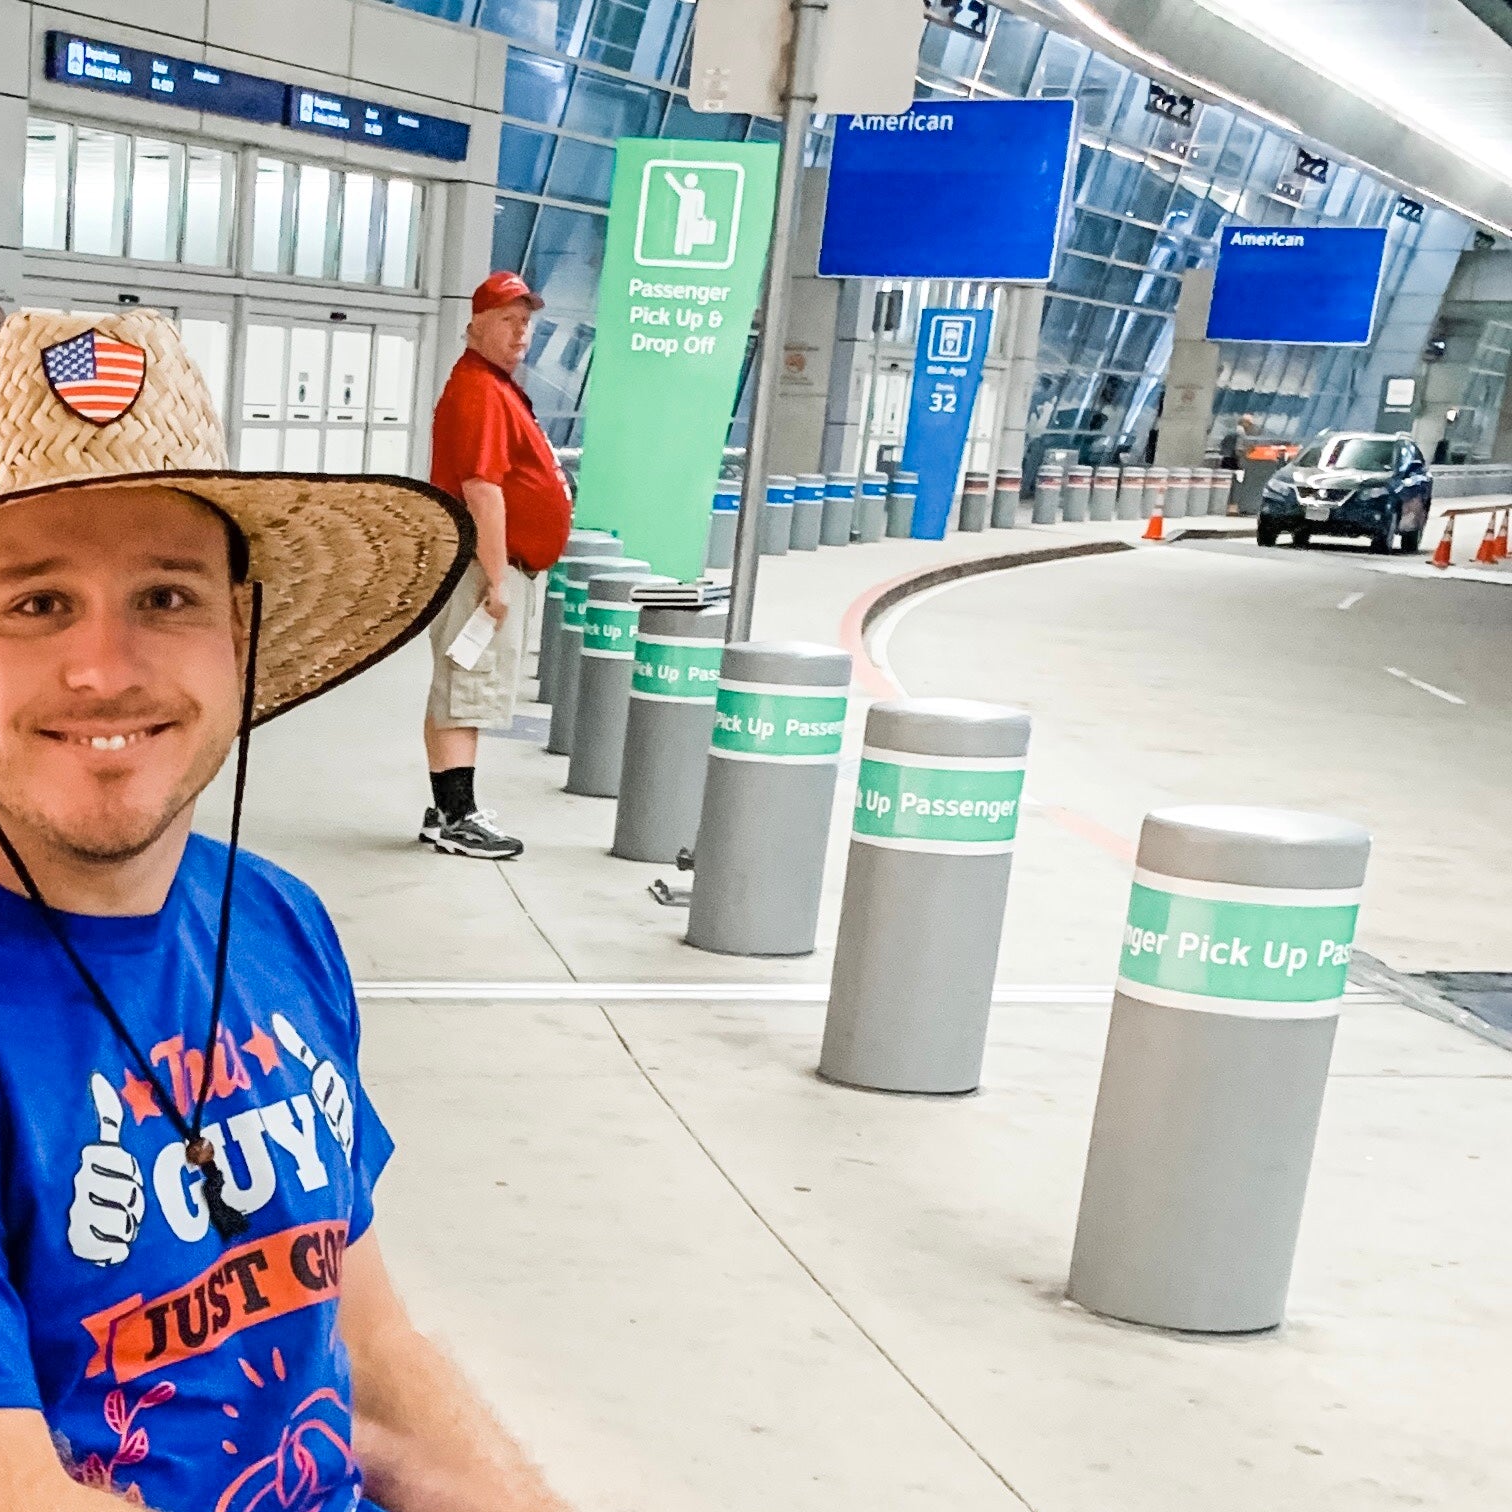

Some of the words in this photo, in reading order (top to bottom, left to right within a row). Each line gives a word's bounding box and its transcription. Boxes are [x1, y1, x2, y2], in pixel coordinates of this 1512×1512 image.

[849, 110, 954, 132] American
[1230, 230, 1305, 247] American
[629, 277, 731, 305] Passenger
[630, 305, 670, 326] Pick
[676, 308, 703, 332] Up
[708, 310, 723, 328] &
[631, 332, 679, 357] Drop
[683, 336, 716, 355] Off
[929, 392, 957, 413] 32
[603, 624, 622, 641] Up
[658, 664, 680, 684] Up
[748, 717, 775, 740] Up
[866, 789, 891, 819] Up
[900, 792, 1017, 823] Passenger
[1177, 932, 1252, 968] Pick
[1263, 940, 1308, 977] Up
[153, 1094, 329, 1243] GUY
[144, 1249, 271, 1362] JUST
